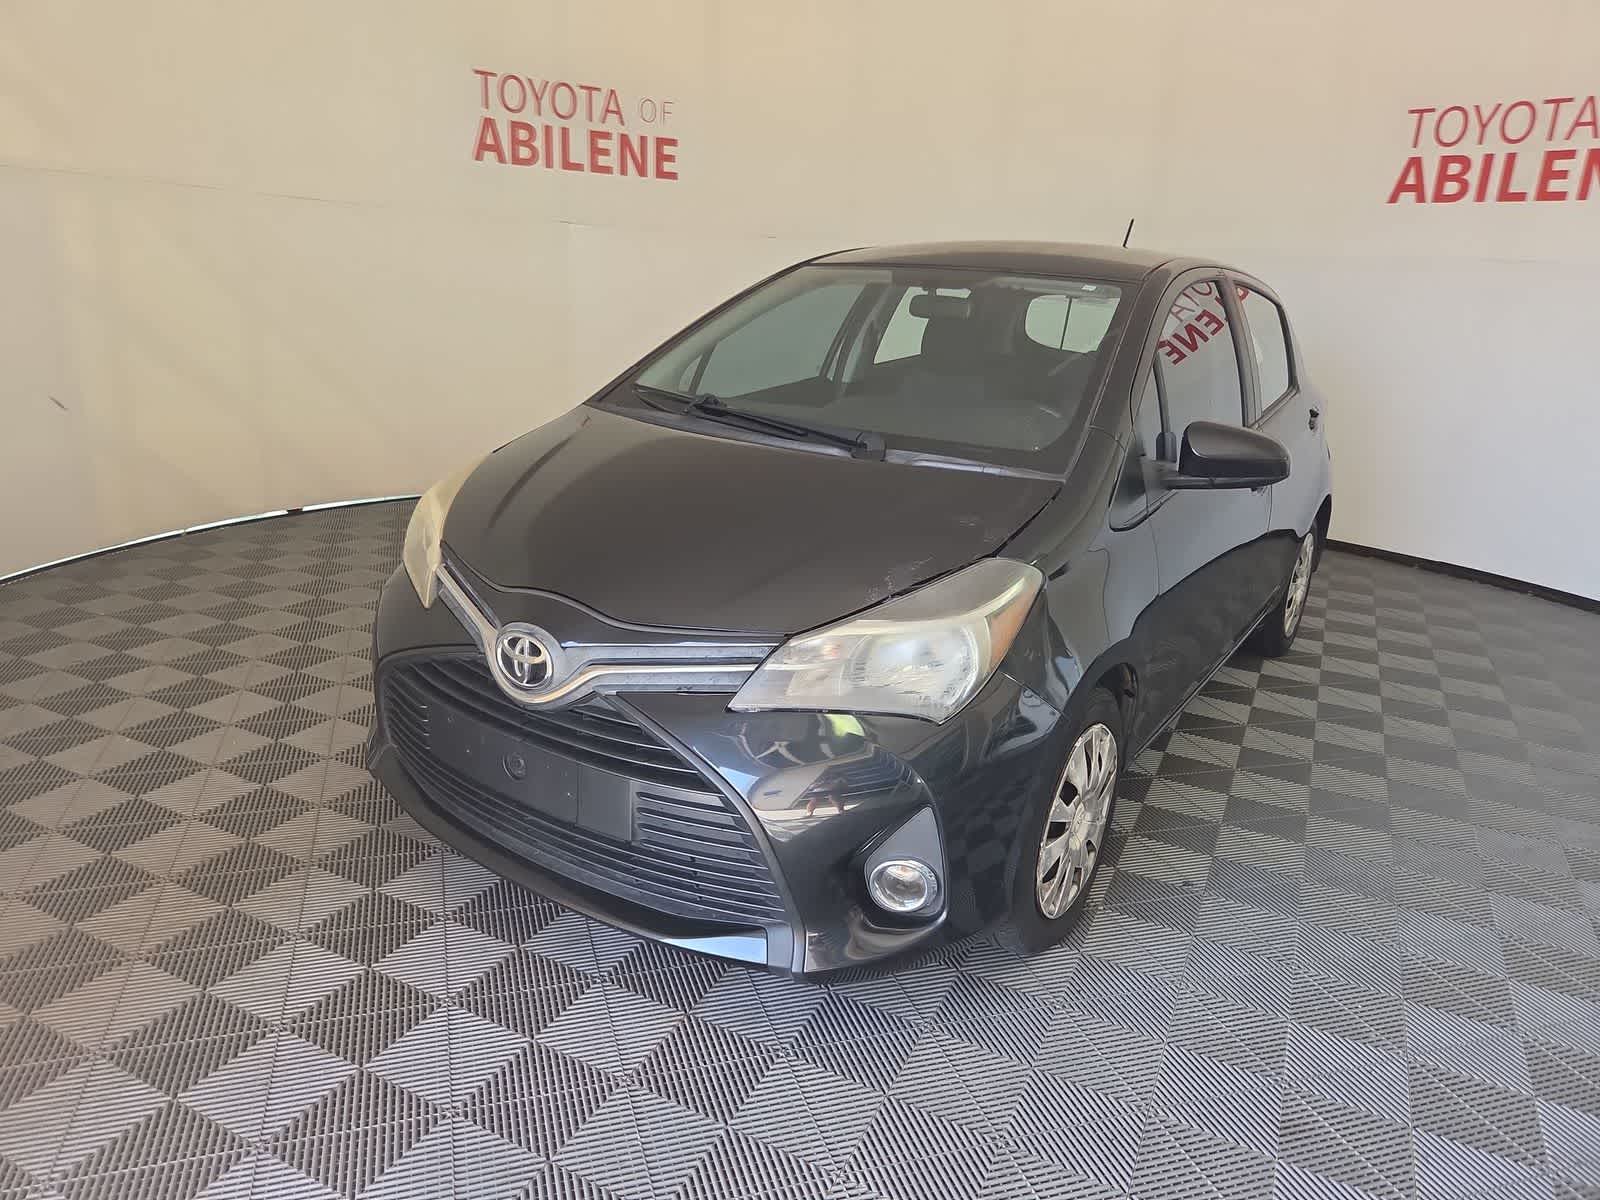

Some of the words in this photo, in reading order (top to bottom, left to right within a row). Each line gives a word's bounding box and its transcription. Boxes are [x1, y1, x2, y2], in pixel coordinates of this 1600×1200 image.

[473, 69, 625, 126] TOYOTA
[639, 98, 675, 124] OF
[1408, 95, 1600, 148] TOYOTA
[474, 117, 678, 180] ABILENE
